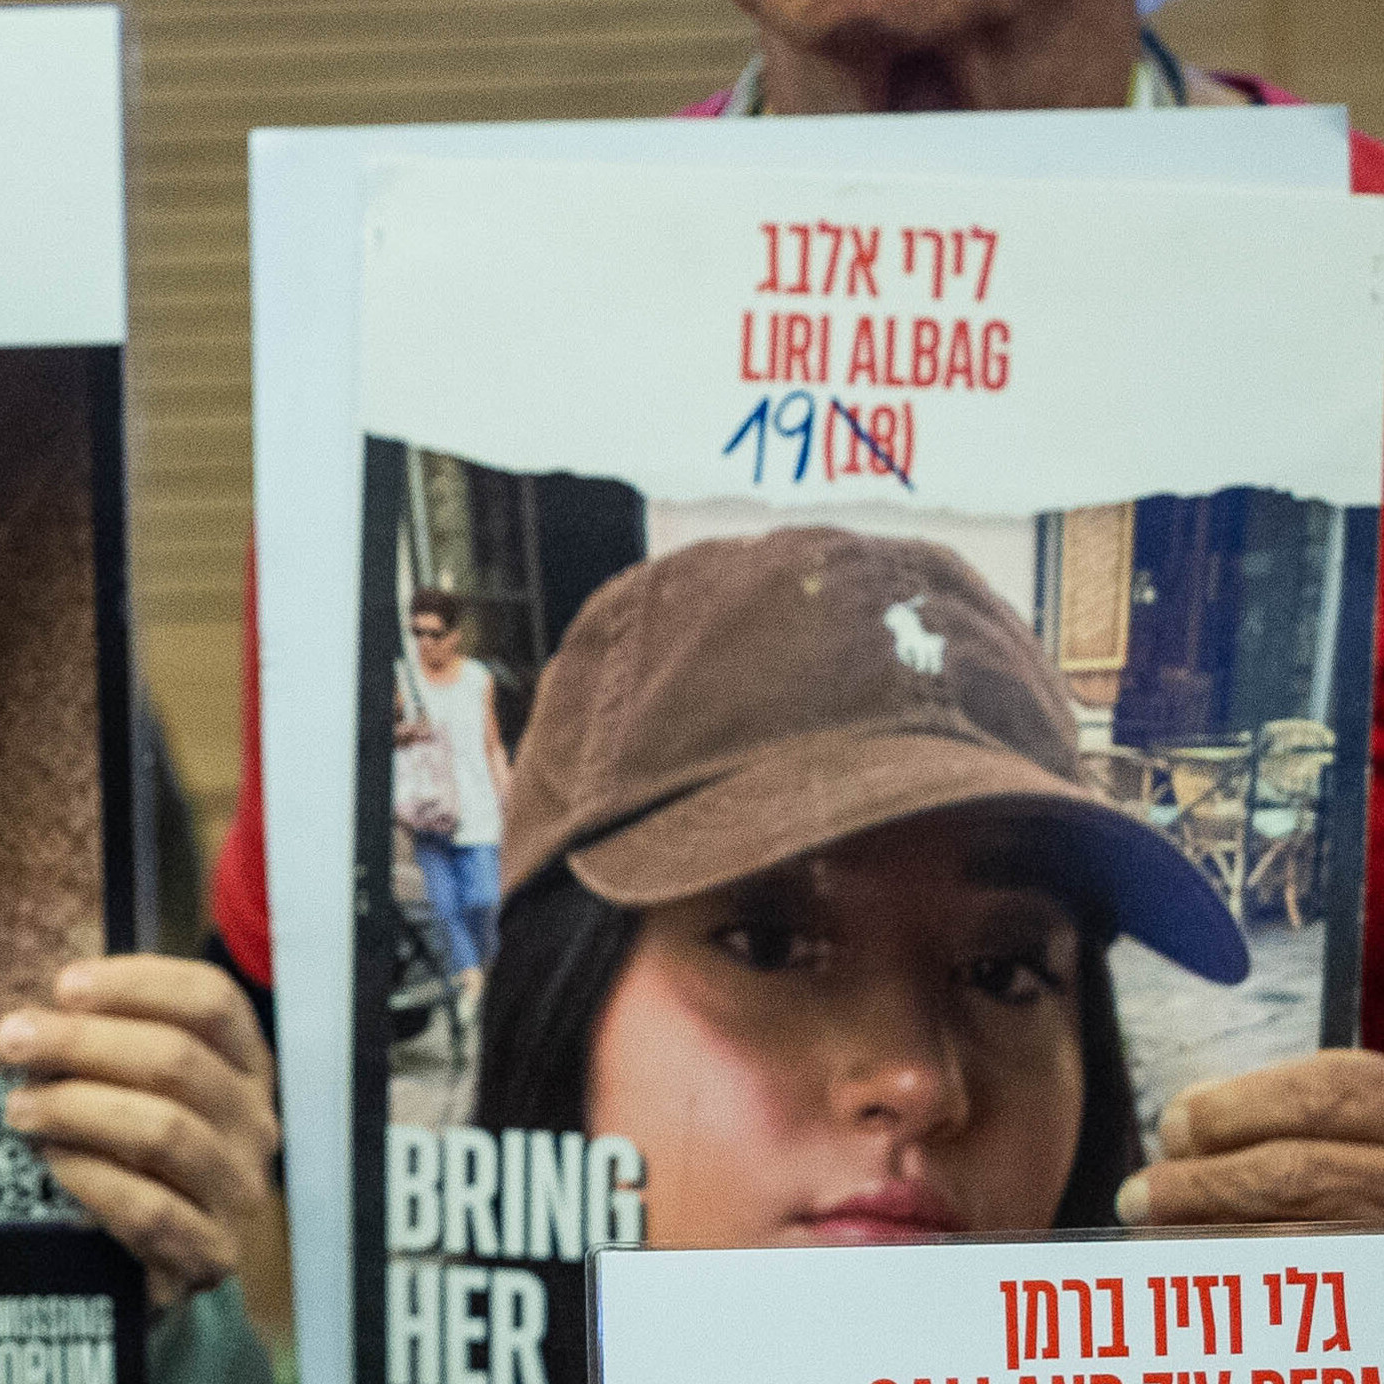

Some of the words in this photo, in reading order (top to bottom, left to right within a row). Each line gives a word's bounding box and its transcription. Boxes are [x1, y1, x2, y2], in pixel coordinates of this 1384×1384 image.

[756, 219, 881, 298] אלבג
[900, 225, 999, 302] לירי
[739, 311, 831, 384] LIRI
[846, 314, 1012, 392] ALBAG
[722, 389, 815, 485] 19
[384, 1124, 646, 1263] BRING
[998, 1277, 1131, 1371] ברמן
[1146, 1273, 1244, 1357] וזיו
[1261, 1266, 1353, 1354] גלי
